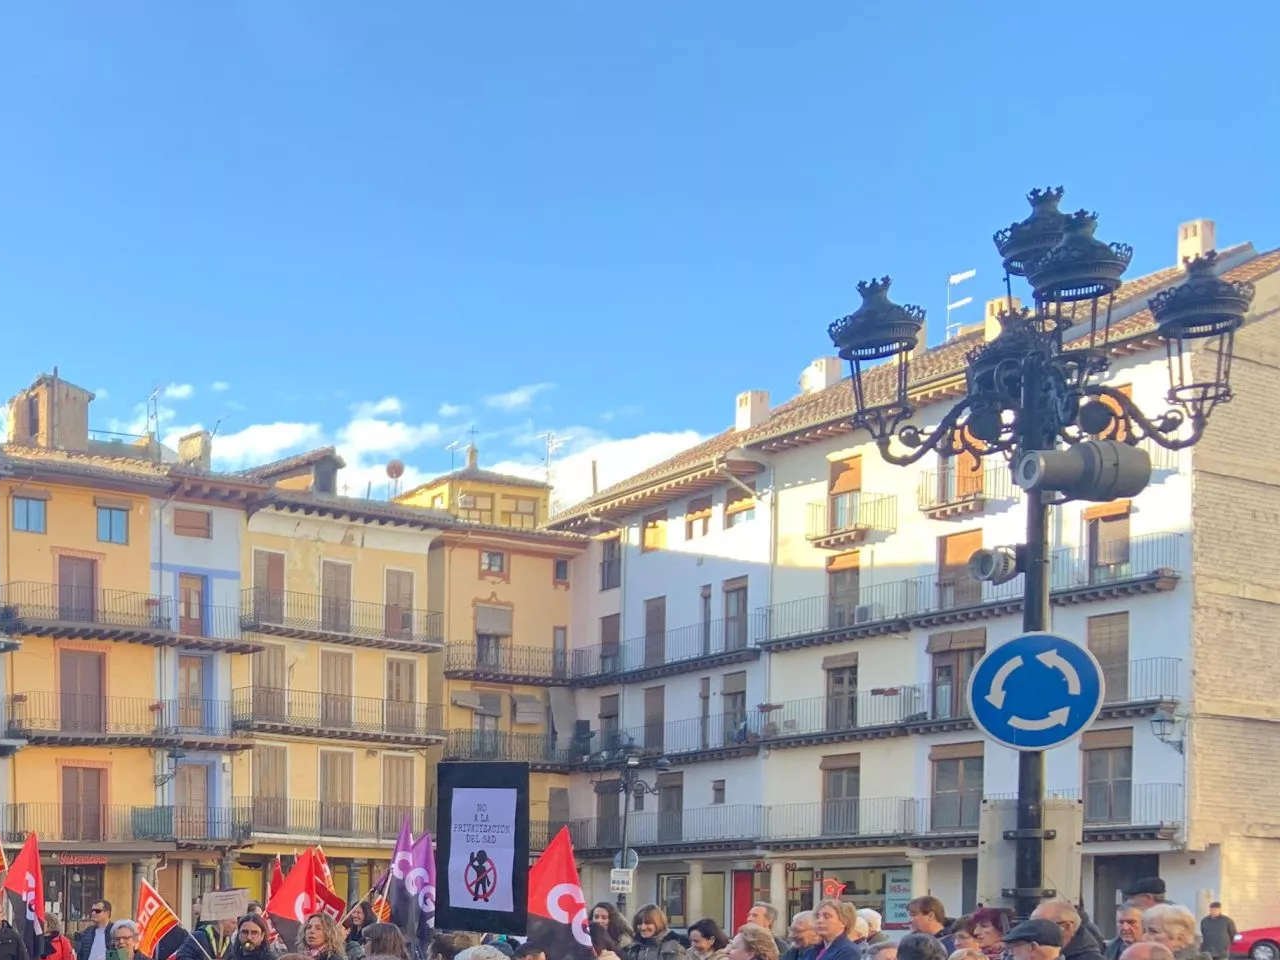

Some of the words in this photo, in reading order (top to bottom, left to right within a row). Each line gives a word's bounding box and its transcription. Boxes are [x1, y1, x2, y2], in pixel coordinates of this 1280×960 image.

[477, 803, 487, 812] NO
[474, 814, 479, 822] A
[480, 814, 489, 822] LA
[466, 834, 480, 843] DEL
[482, 834, 497, 844] SAD
